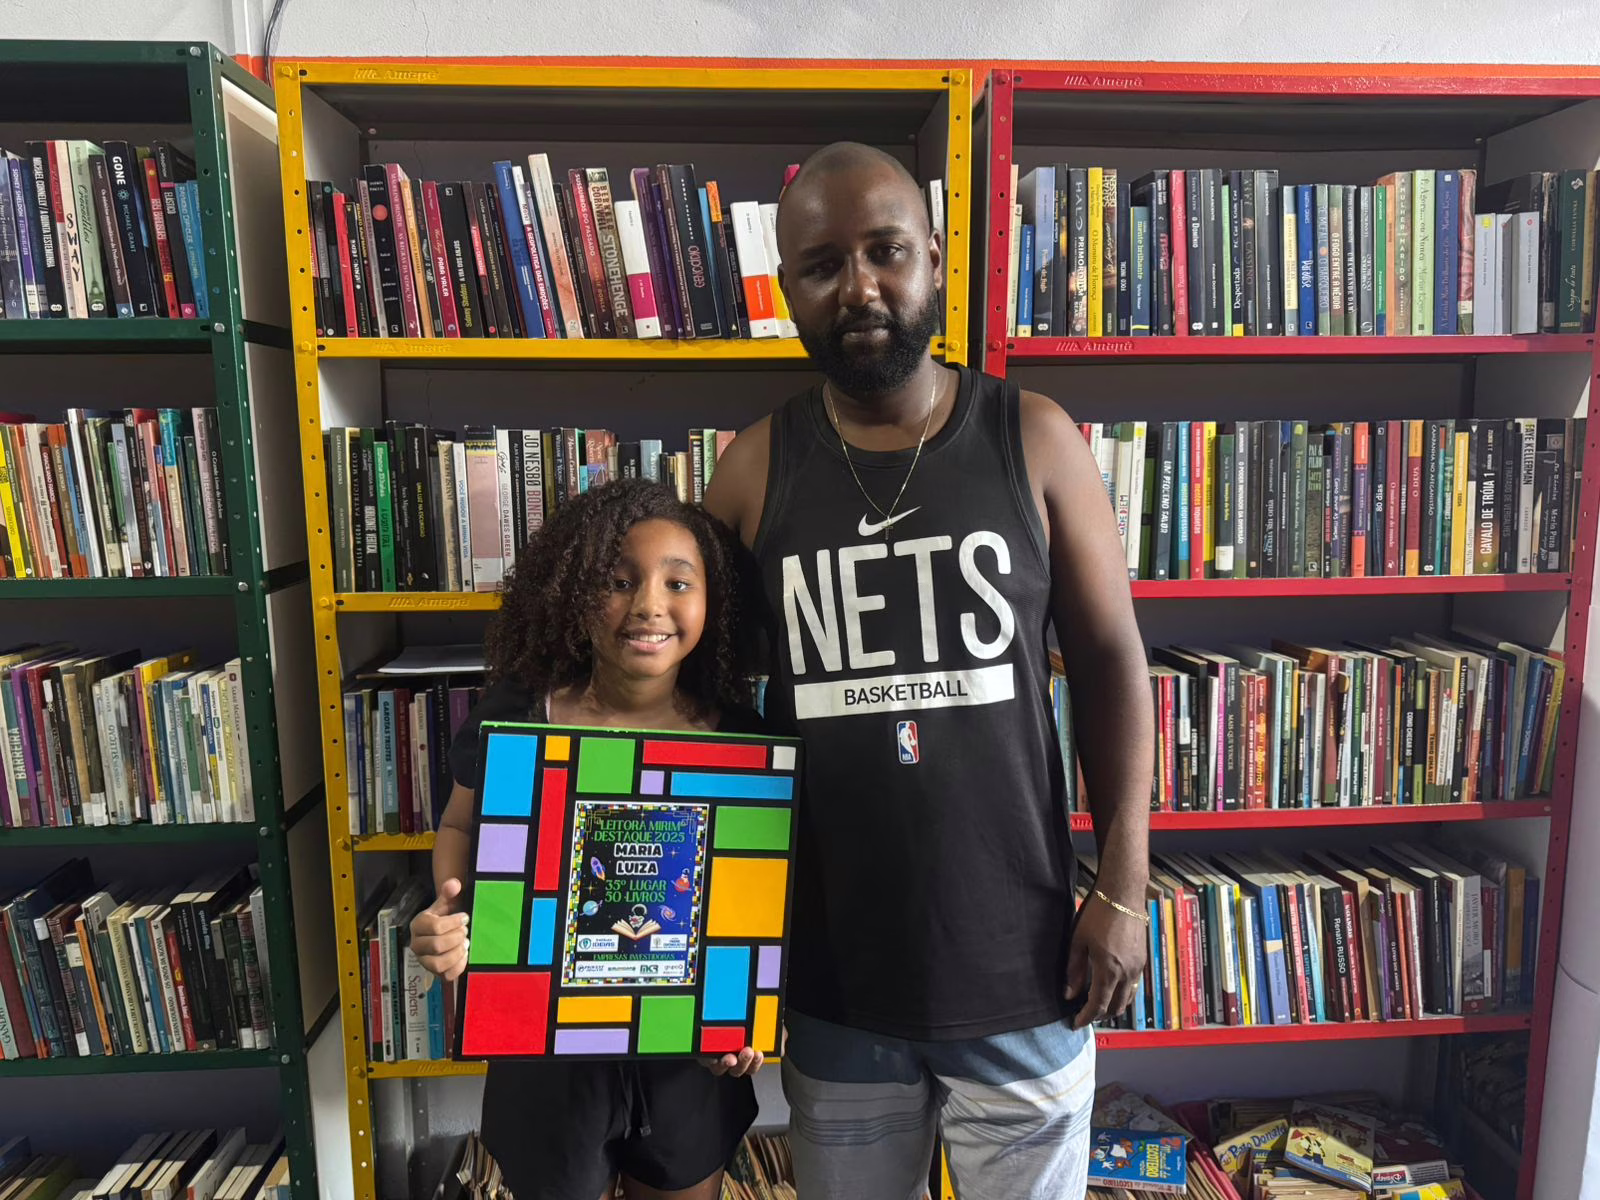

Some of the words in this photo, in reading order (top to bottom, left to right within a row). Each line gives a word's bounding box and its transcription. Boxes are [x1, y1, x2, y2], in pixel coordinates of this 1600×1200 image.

[32, 157, 42, 180] MICHAEL
[112, 156, 126, 185] GONE
[36, 180, 47, 207] CONNELLY
[574, 173, 587, 212] SUSSURROS
[122, 204, 131, 231] MICHAEL
[127, 231, 136, 253] GRANT
[582, 213, 590, 224] DO
[43, 233, 55, 268] TESTEMUNHA
[584, 225, 596, 257] PASSADO
[1332, 239, 1340, 256] FOGO
[602, 235, 628, 318] STONEHENGE
[1332, 258, 1340, 279] ENTRE
[1233, 267, 1242, 309] Despertada
[523, 435, 539, 447] JO
[1524, 424, 1535, 441] FAYE
[524, 452, 541, 486] NESBØ
[1523, 443, 1534, 485] KELLERMAN
[1481, 480, 1495, 506] TRÓIA
[1376, 502, 1383, 512] 80
[1482, 508, 1494, 519] DE
[1480, 521, 1494, 554] CAVALO
[783, 531, 1015, 675] NETS
[844, 679, 968, 706] BASKETBALL
[383, 701, 391, 733] GAROTAS
[9, 727, 27, 780] BARREIRA
[594, 831, 653, 843] DESTAQUE
[655, 832, 685, 842] 2025
[600, 820, 646, 831] LEITORA
[649, 821, 680, 832] MIRIM
[614, 843, 663, 857] MARIA
[616, 861, 658, 875] LUIZA
[605, 892, 622, 902] 50
[625, 892, 666, 902] LIVROS
[629, 880, 667, 891] LUGAR
[198, 910, 208, 935] querida
[1334, 918, 1342, 945] Renato
[593, 953, 628, 961] EMPRESAS
[1336, 946, 1346, 974] RUSSO
[408, 975, 422, 1017] Sapiens
[1251, 1124, 1287, 1147] Donald
[1146, 1143, 1160, 1178] ESCOTEIRO
